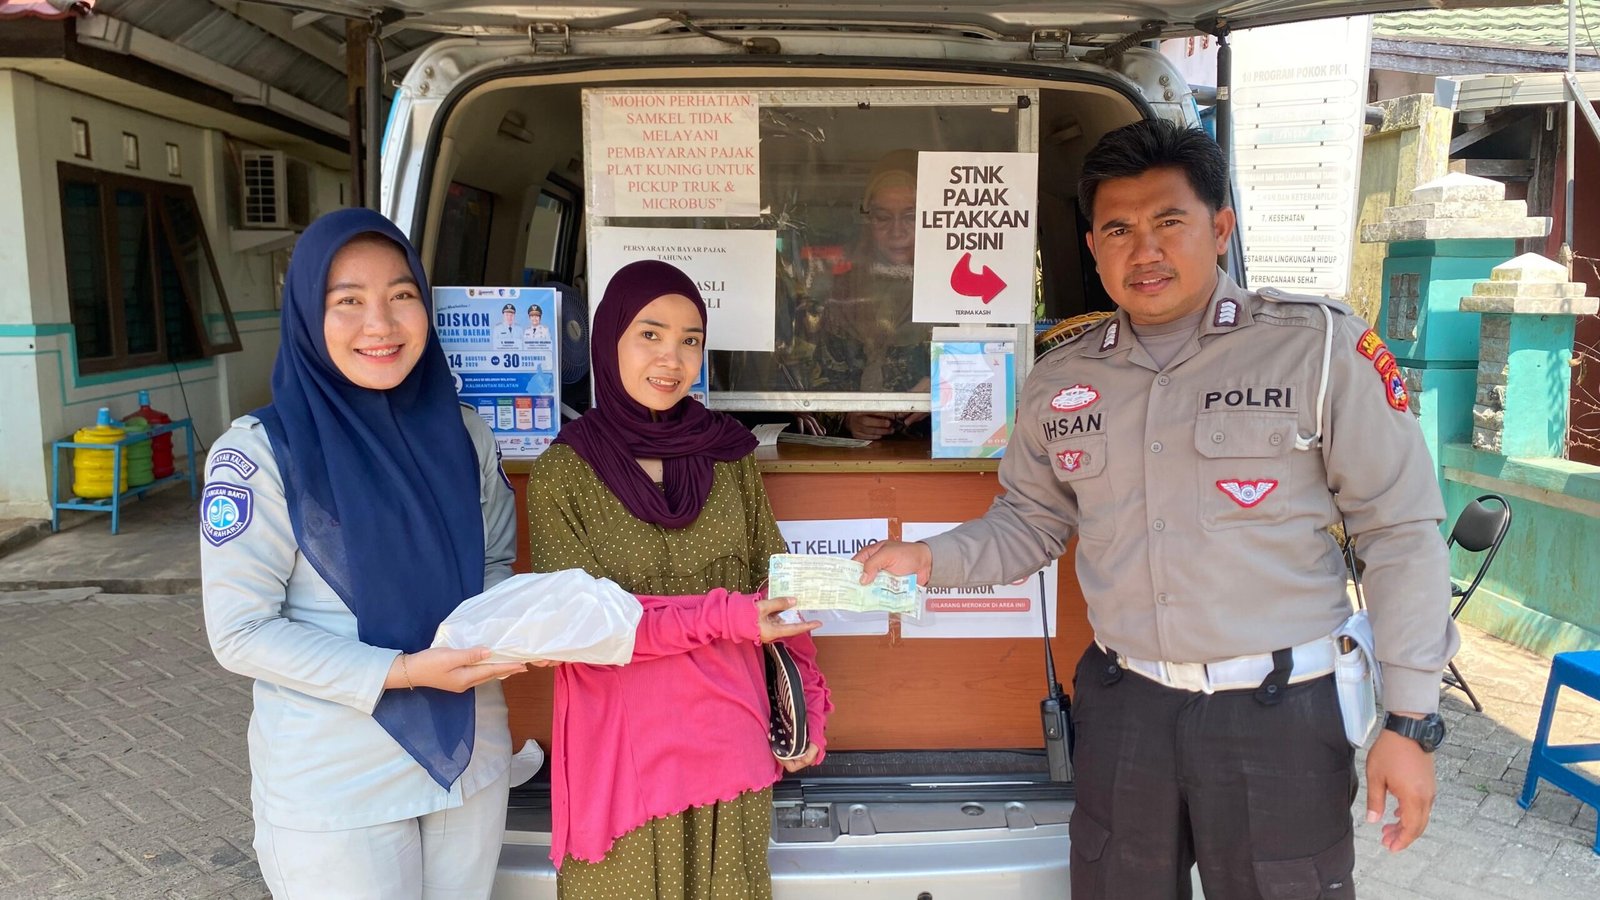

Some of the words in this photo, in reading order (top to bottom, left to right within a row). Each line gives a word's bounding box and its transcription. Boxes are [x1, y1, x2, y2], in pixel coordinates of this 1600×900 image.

[1253, 68, 1294, 82] PROGRAM
[1296, 65, 1327, 78] POKOK
[627, 112, 685, 124] SAMKEL
[689, 112, 733, 124] TIDAK
[642, 130, 718, 141] MELAYANI
[607, 147, 706, 158] PEMBAYARAN
[711, 147, 754, 158] PAJAK
[607, 164, 643, 175] PLAT
[647, 164, 702, 175] KUNING
[707, 164, 756, 175] UNTUK
[950, 166, 1004, 184] STNK
[628, 181, 678, 193] PICKUP
[683, 181, 720, 192] TRUK
[724, 181, 735, 192] &
[943, 188, 1009, 206] PAJAK
[922, 210, 1029, 228] LETAKKAN
[1268, 214, 1305, 222] KESEHATAN
[946, 232, 1003, 250] DISINI
[677, 245, 702, 253] BAYAR
[1274, 255, 1315, 263] LINGKUNGAN
[1317, 255, 1337, 264] HIDUP
[1250, 275, 1296, 284] PERENCANAAN
[1297, 276, 1317, 284] SEHAT
[437, 312, 490, 327] DISKON
[448, 354, 462, 368] 14
[503, 353, 520, 368] 30
[1204, 388, 1291, 409] POLRI
[1042, 413, 1102, 441] IHSAN
[228, 490, 247, 500] BAKTI
[213, 522, 244, 537] RAHARJA
